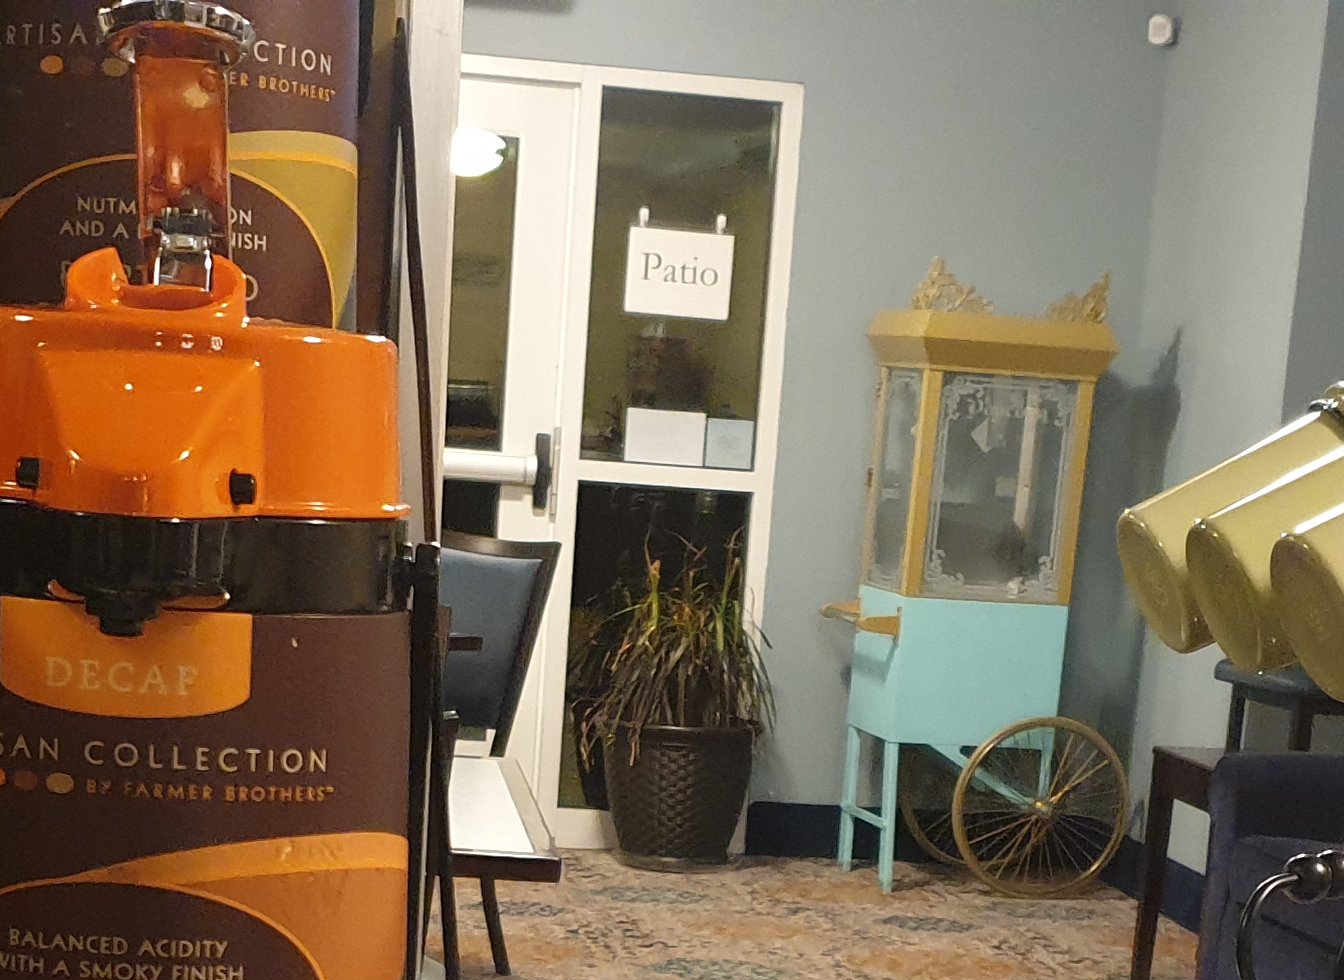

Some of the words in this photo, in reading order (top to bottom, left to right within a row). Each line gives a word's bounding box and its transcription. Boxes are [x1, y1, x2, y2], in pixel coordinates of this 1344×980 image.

[59, 219, 105, 237] AND
[641, 252, 719, 287] Patio
[45, 654, 199, 698] DECAF
[84, 740, 327, 774] COLLECTION
[123, 781, 214, 801] FARMER
[9, 927, 128, 956] BALANCED
[138, 938, 230, 960] ACIDITY
[52, 958, 71, 978] A
